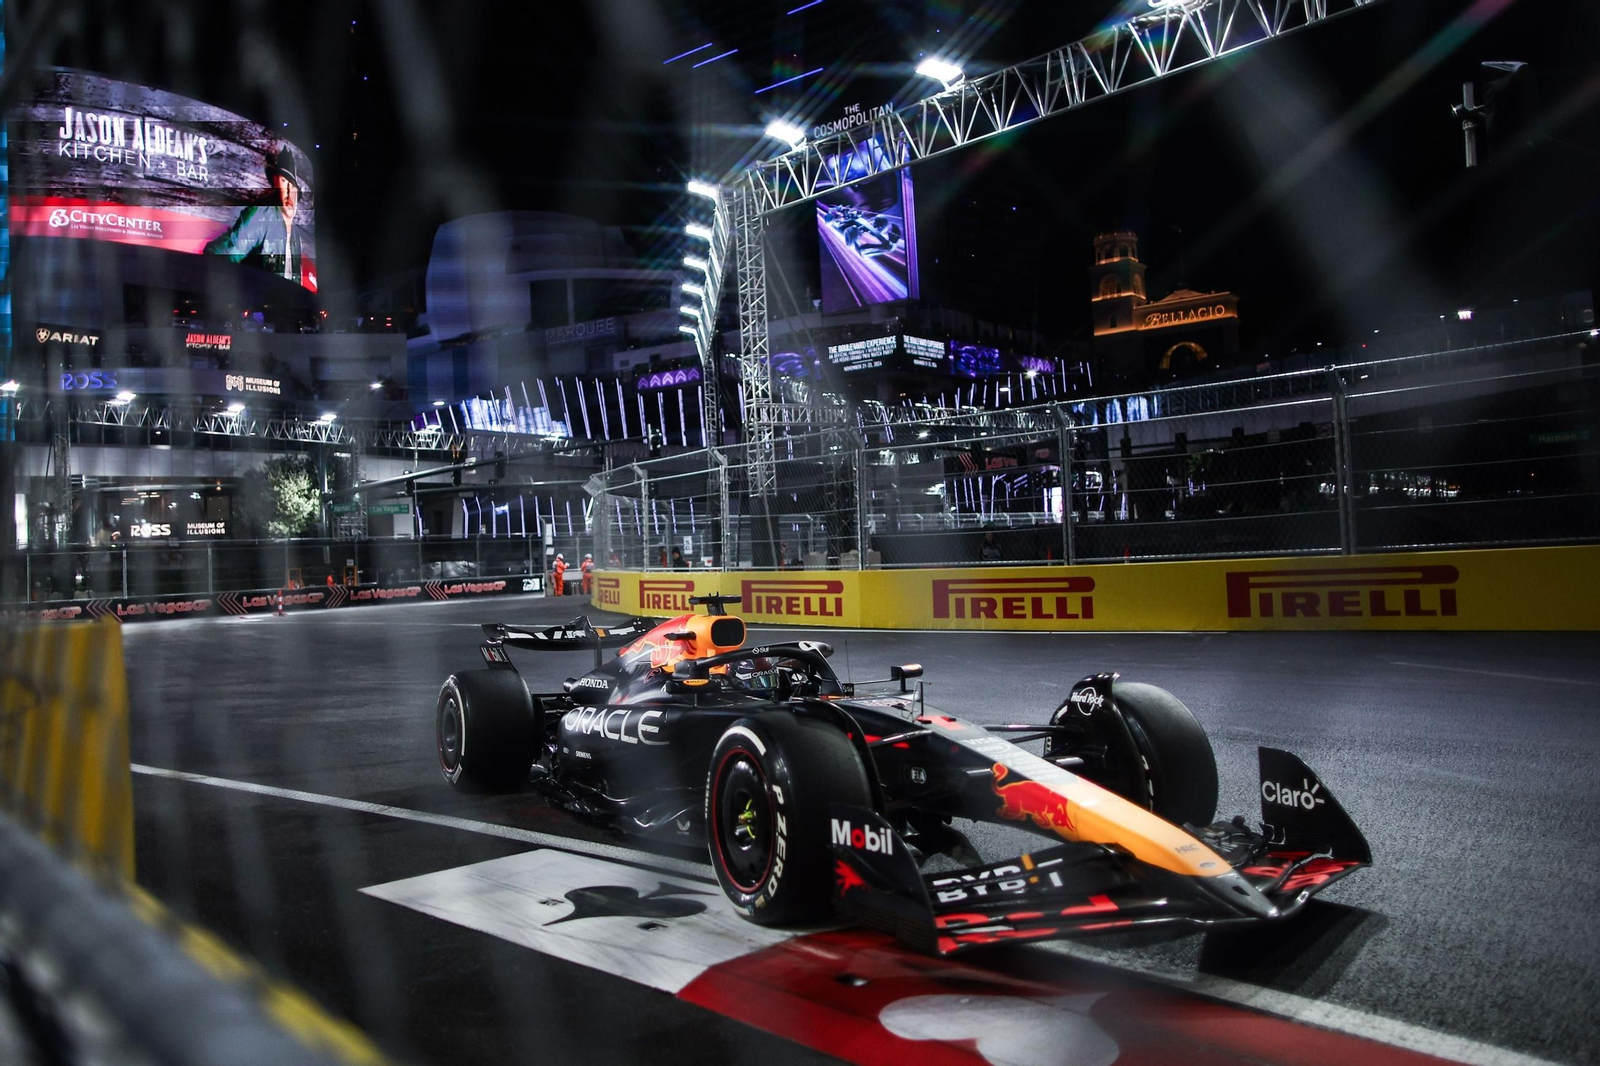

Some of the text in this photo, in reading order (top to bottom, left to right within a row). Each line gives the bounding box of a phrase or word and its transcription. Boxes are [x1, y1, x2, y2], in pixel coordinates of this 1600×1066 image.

[813, 102, 894, 139] COSMOPOLITAN
[844, 103, 860, 113] THE
[59, 107, 208, 164] JASON ALDEAN'S
[58, 141, 151, 169] KITCHEN
[176, 160, 209, 182] BAR
[1144, 304, 1226, 327] BELLAGIO
[49, 332, 99, 346] ARIAT
[186, 333, 205, 344] JASON
[545, 317, 614, 342] MARQUEE
[60, 371, 117, 390] ROSS
[245, 377, 280, 388] MUSEUM OF
[245, 384, 281, 395] ILLUSIONS
[372, 504, 382, 512] Las
[383, 504, 400, 513] Vegas
[130, 523, 171, 538] ROSS
[598, 578, 620, 605] PRELLI
[639, 580, 695, 611] PIRELLI
[741, 579, 844, 617] PIRELLI
[932, 576, 1095, 620] PIRELLI
[1225, 565, 1460, 618] PIRELLI
[579, 677, 609, 689] HONDA
[1071, 691, 1088, 703] Hard
[564, 706, 670, 746] ORACLE
[911, 769, 926, 783] FIA
[1261, 779, 1318, 810] Claro
[767, 784, 788, 898] P ZERO
[831, 818, 893, 856] Mobil
